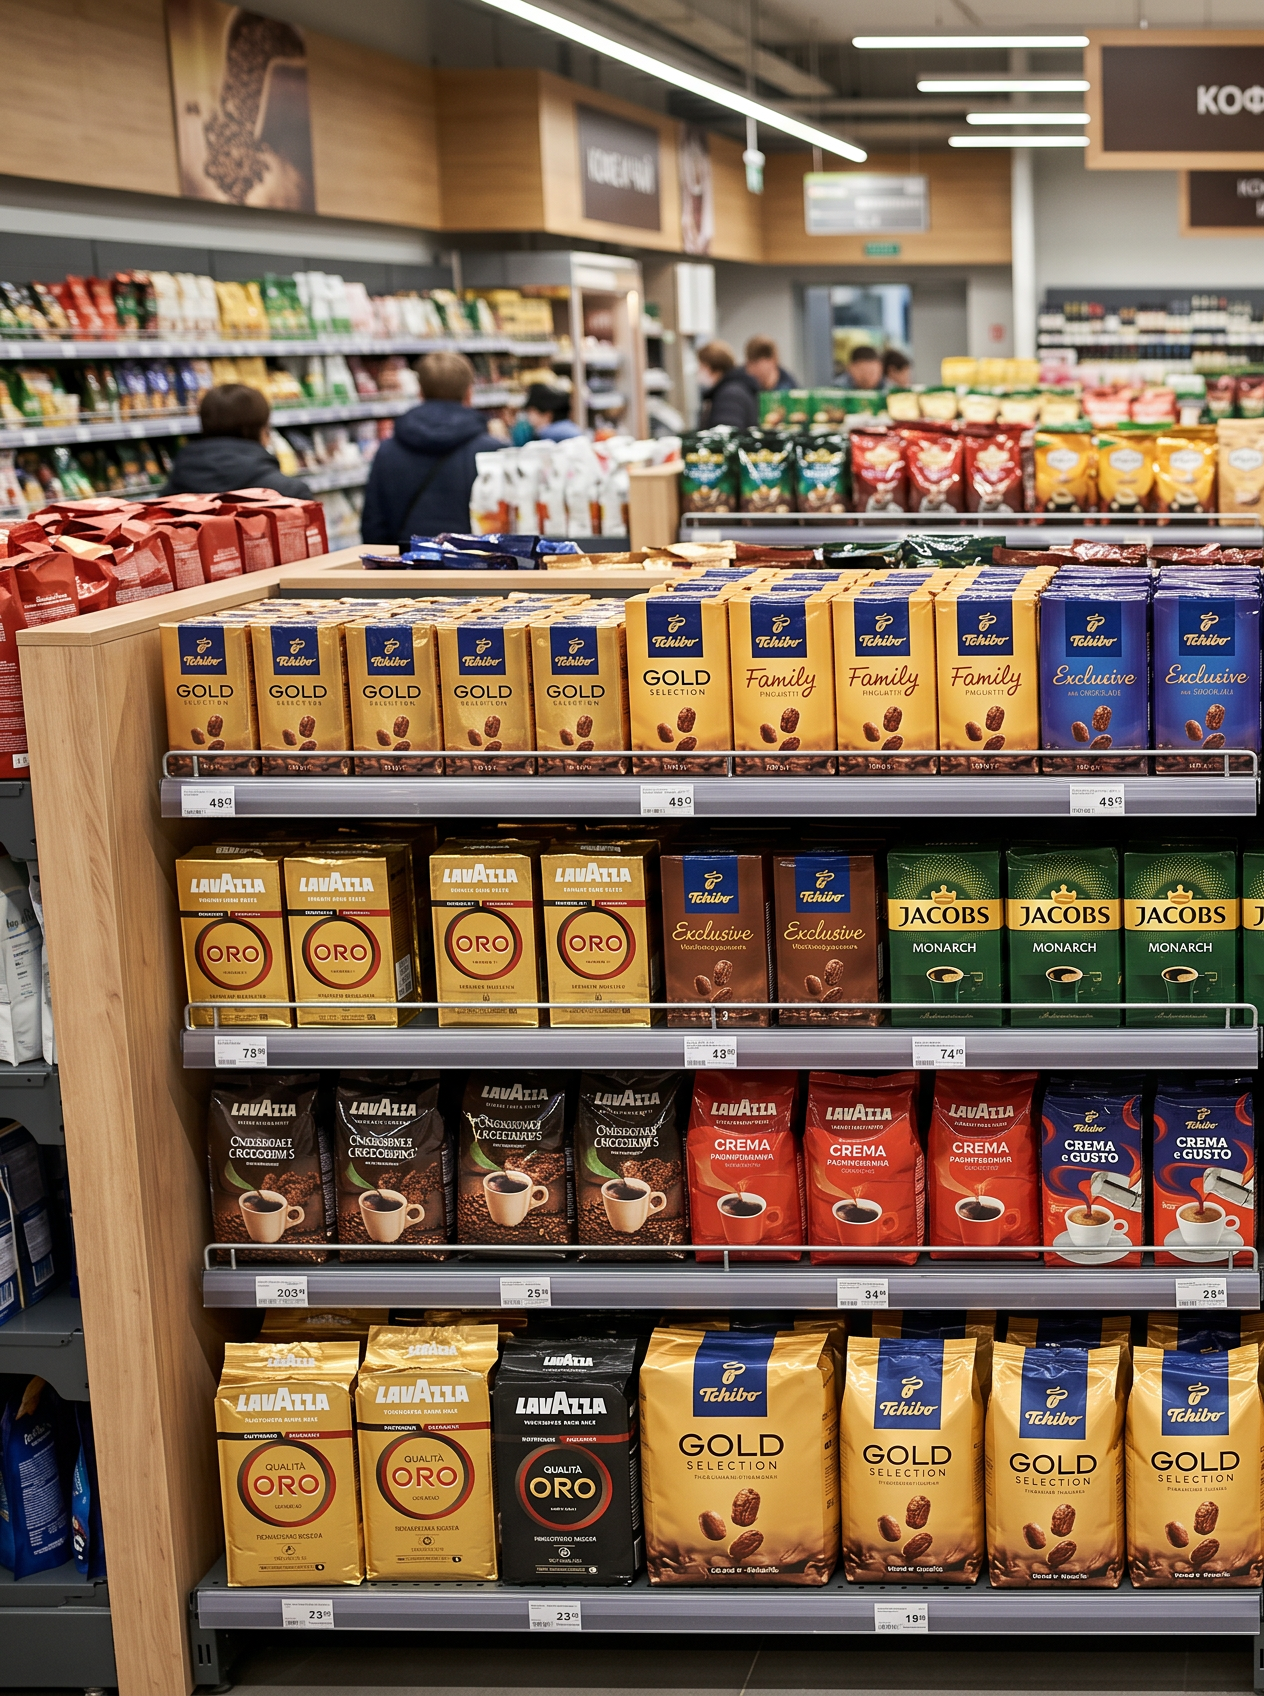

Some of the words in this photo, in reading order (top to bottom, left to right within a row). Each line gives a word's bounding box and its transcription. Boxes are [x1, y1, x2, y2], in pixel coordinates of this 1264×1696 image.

[652, 634, 699, 649] Tchibo
[756, 634, 803, 649] Tchibo
[859, 633, 906, 648] Tchibo
[962, 632, 1009, 648] Tchibo
[643, 670, 710, 686] GOLD
[746, 665, 817, 699] Family
[848, 664, 920, 698] Family
[951, 664, 1022, 697] Family
[1052, 664, 1137, 686] Exclusive
[176, 684, 234, 699] GOLD
[269, 684, 327, 699] GOLD
[362, 684, 421, 699] GOLD
[454, 684, 513, 699] GOLD
[546, 684, 605, 699] GOLD
[443, 864, 518, 884] LAVAZZA
[555, 862, 631, 883] LAVAZZA
[191, 873, 266, 894] LAVAZZA
[300, 872, 374, 893] LAVAZZA
[688, 892, 734, 905] Tchibo
[899, 906, 989, 927] JACOBS
[1020, 906, 1110, 926] JACOBS
[1135, 905, 1226, 927] JACOBS
[672, 921, 754, 943] Exclusive
[784, 921, 866, 942] Exclusive
[455, 934, 509, 953] ORO
[569, 934, 623, 953] ORO
[912, 942, 977, 953] MONARCH
[1033, 942, 1097, 953] MONARCH
[1148, 942, 1213, 953] MONARCH
[206, 944, 260, 963] ORO
[313, 943, 368, 962] ORO
[714, 1138, 771, 1153] CREMA
[952, 1141, 1009, 1155] CREMA
[1064, 1139, 1116, 1153] CREMA
[1176, 1135, 1228, 1150] CREMA
[829, 1144, 887, 1158] CREMA
[1061, 1153, 1071, 1163] e
[1072, 1150, 1119, 1164] GUSTO
[1173, 1150, 1182, 1161] e
[1182, 1146, 1232, 1161] GUSTO
[237, 1387, 330, 1412] LAVAZZA
[375, 1379, 470, 1404] LAVAZZA
[699, 1388, 763, 1403] Tchibo
[515, 1391, 607, 1415] LAVAZZA
[879, 1401, 939, 1417] Tchibo
[1025, 1410, 1083, 1427] Tchibo
[1167, 1408, 1226, 1424] Tchibo
[679, 1433, 785, 1457] GOLD
[404, 1452, 445, 1464] QUALITÀ
[863, 1444, 952, 1466] GOLD
[1151, 1450, 1240, 1471] GOLD
[265, 1462, 306, 1472] QUALITÀ
[543, 1464, 583, 1475] QUALITÀ
[686, 1460, 778, 1471] SELECTION
[1009, 1452, 1098, 1475] GOLD
[392, 1466, 459, 1489] ORO
[869, 1468, 947, 1478] SELECTION
[1158, 1474, 1235, 1483] SELECTION
[253, 1474, 320, 1496] ORO
[529, 1476, 596, 1499] ORO
[1015, 1476, 1091, 1487] SELECTION
